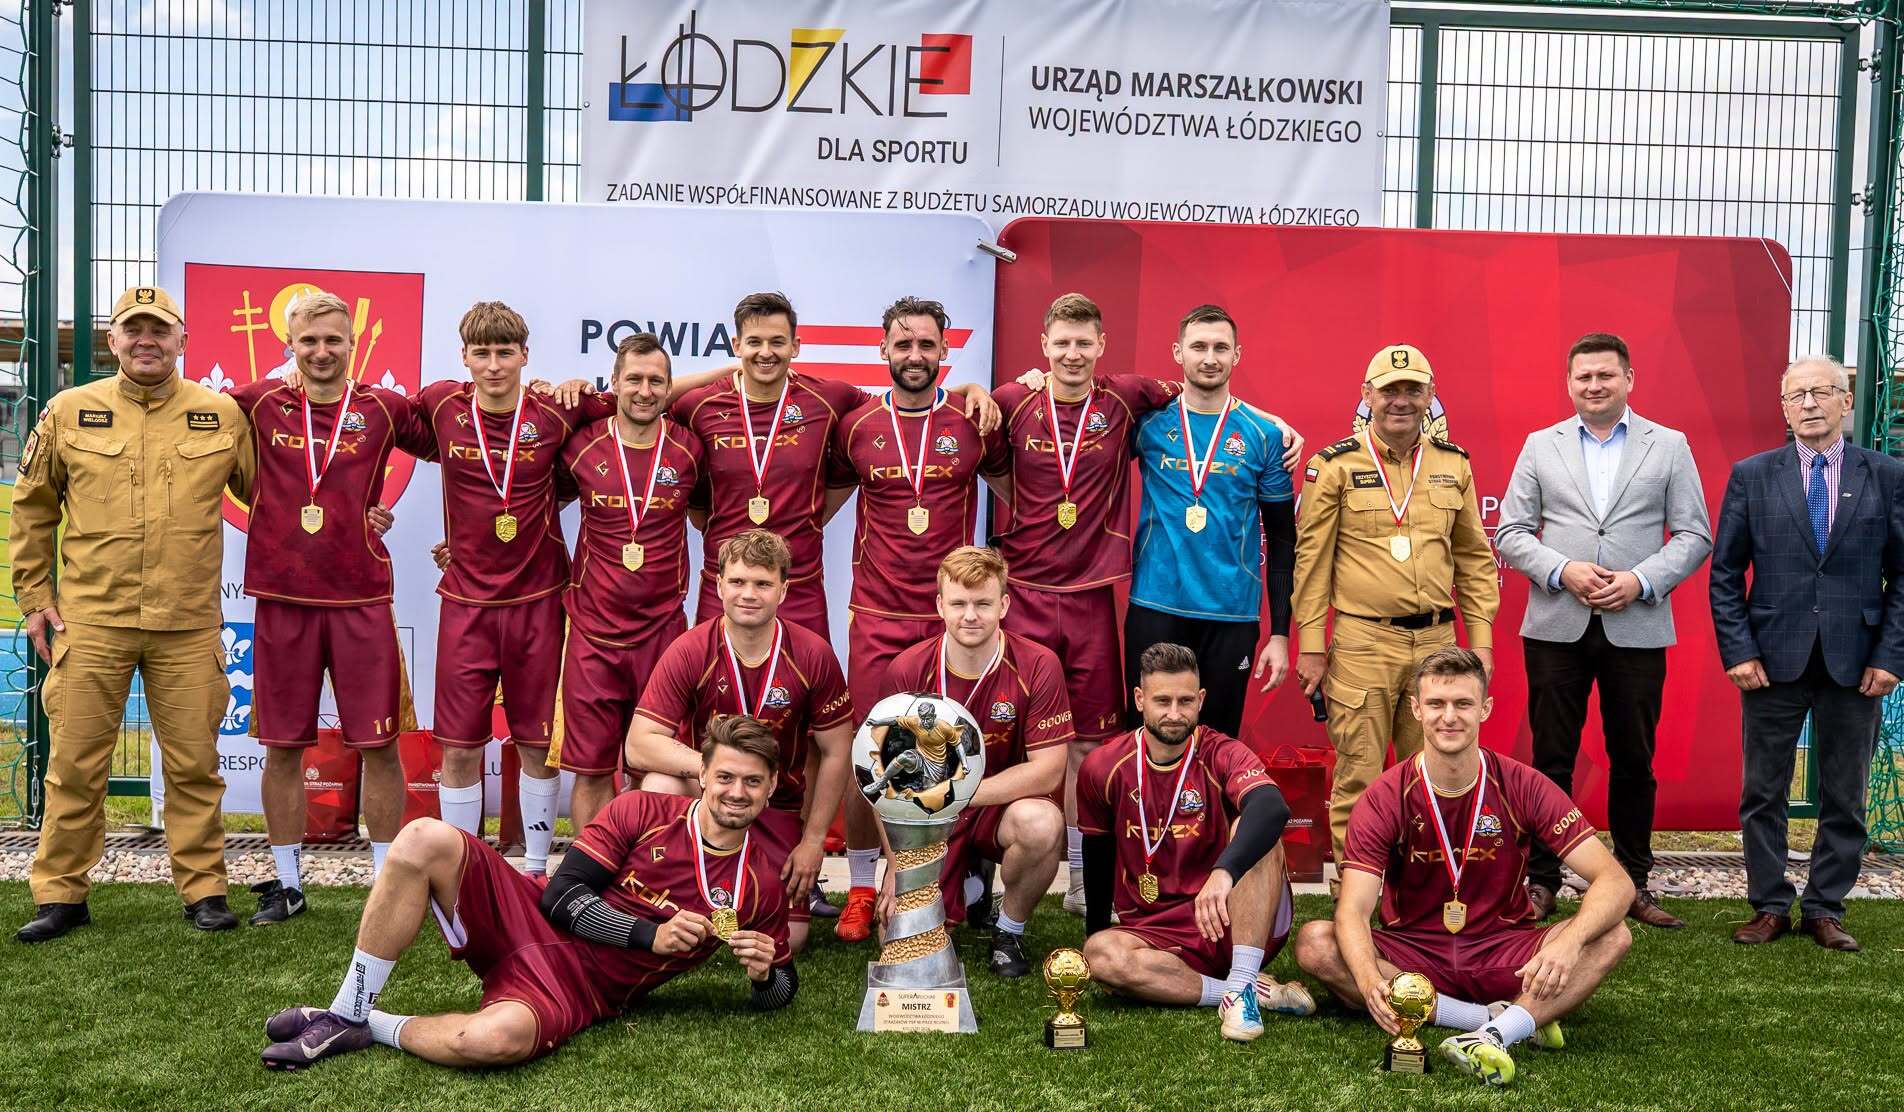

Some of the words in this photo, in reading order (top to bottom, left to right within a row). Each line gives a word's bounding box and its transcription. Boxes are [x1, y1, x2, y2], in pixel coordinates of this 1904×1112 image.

[1031, 65, 1122, 101] URZĄD
[1131, 72, 1363, 105] MARSZAŁKOWSKI
[1029, 106, 1219, 138] WOJEWÓDZTWA
[1226, 111, 1362, 143] ŁÓDZKIEGO
[818, 137, 865, 162] DLA
[872, 139, 968, 164] SPORTU
[606, 183, 685, 202] ZADANIE
[688, 184, 882, 209] WSPÓŁFINANSOWANE
[887, 191, 898, 209] Z
[904, 188, 987, 212] BUDŻETU
[992, 194, 1106, 218] SAMORZĄDU
[1111, 199, 1254, 225] WOJEWÓDZTWA
[1258, 203, 1360, 227] ŁÓDZKIEGO
[580, 319, 735, 357] POWIA
[902, 1003, 932, 1011] MISTRZ
